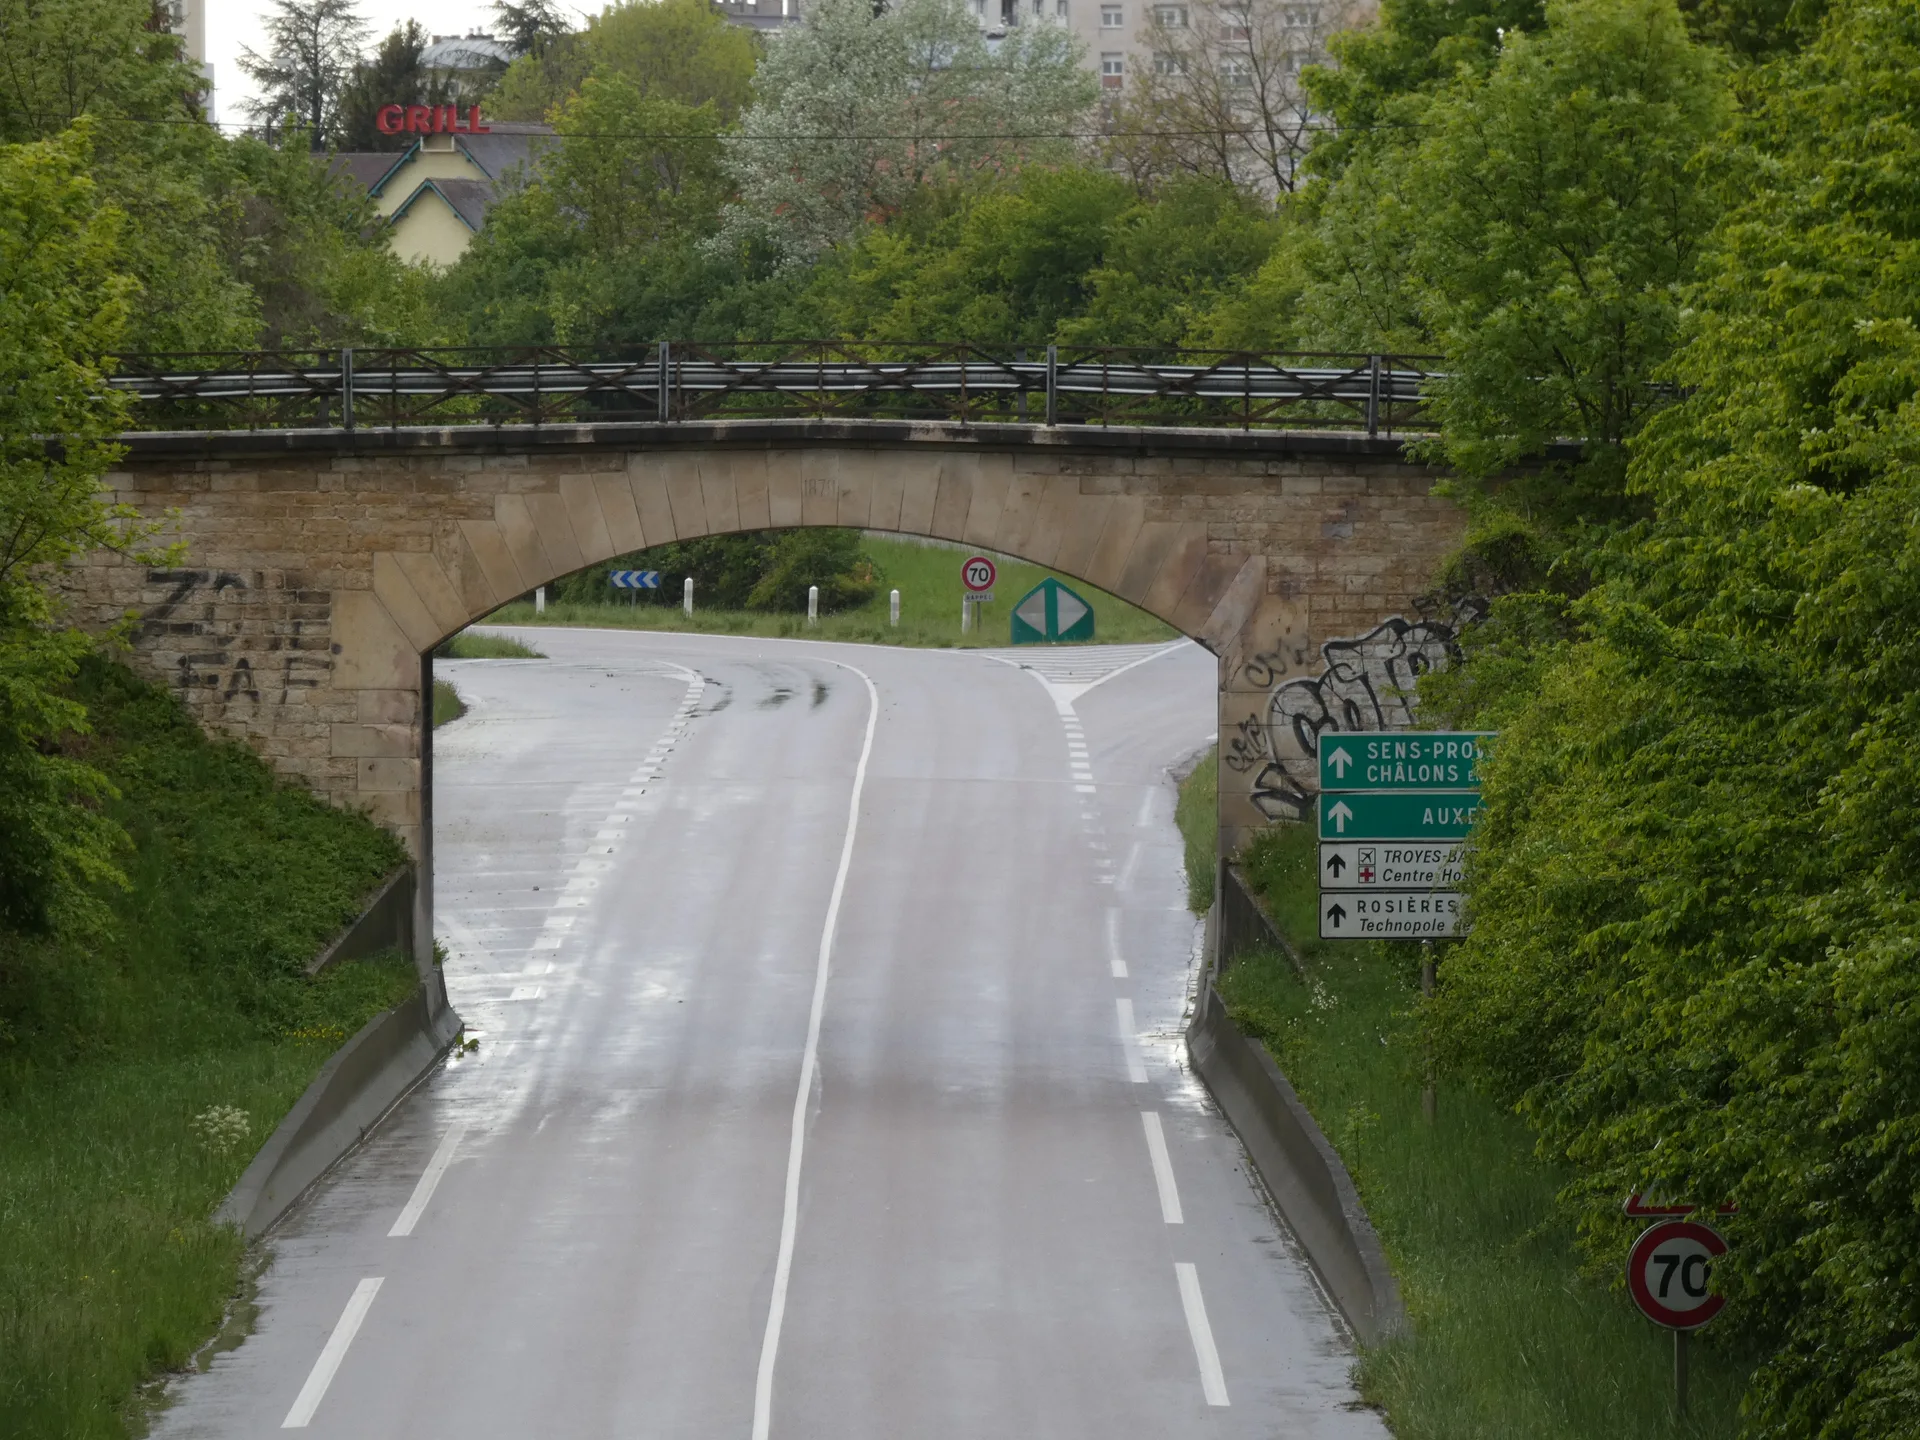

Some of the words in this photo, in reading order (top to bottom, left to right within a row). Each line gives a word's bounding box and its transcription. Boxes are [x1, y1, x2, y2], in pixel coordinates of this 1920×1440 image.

[376, 104, 491, 135] GRILL
[969, 567, 989, 582] 70
[1366, 762, 1459, 783] CHÂLONS
[1382, 869, 1434, 882] Centre
[1357, 896, 1458, 913] ROSIÈRES
[1360, 918, 1445, 935] Technopole
[1653, 1254, 1713, 1298] 70
